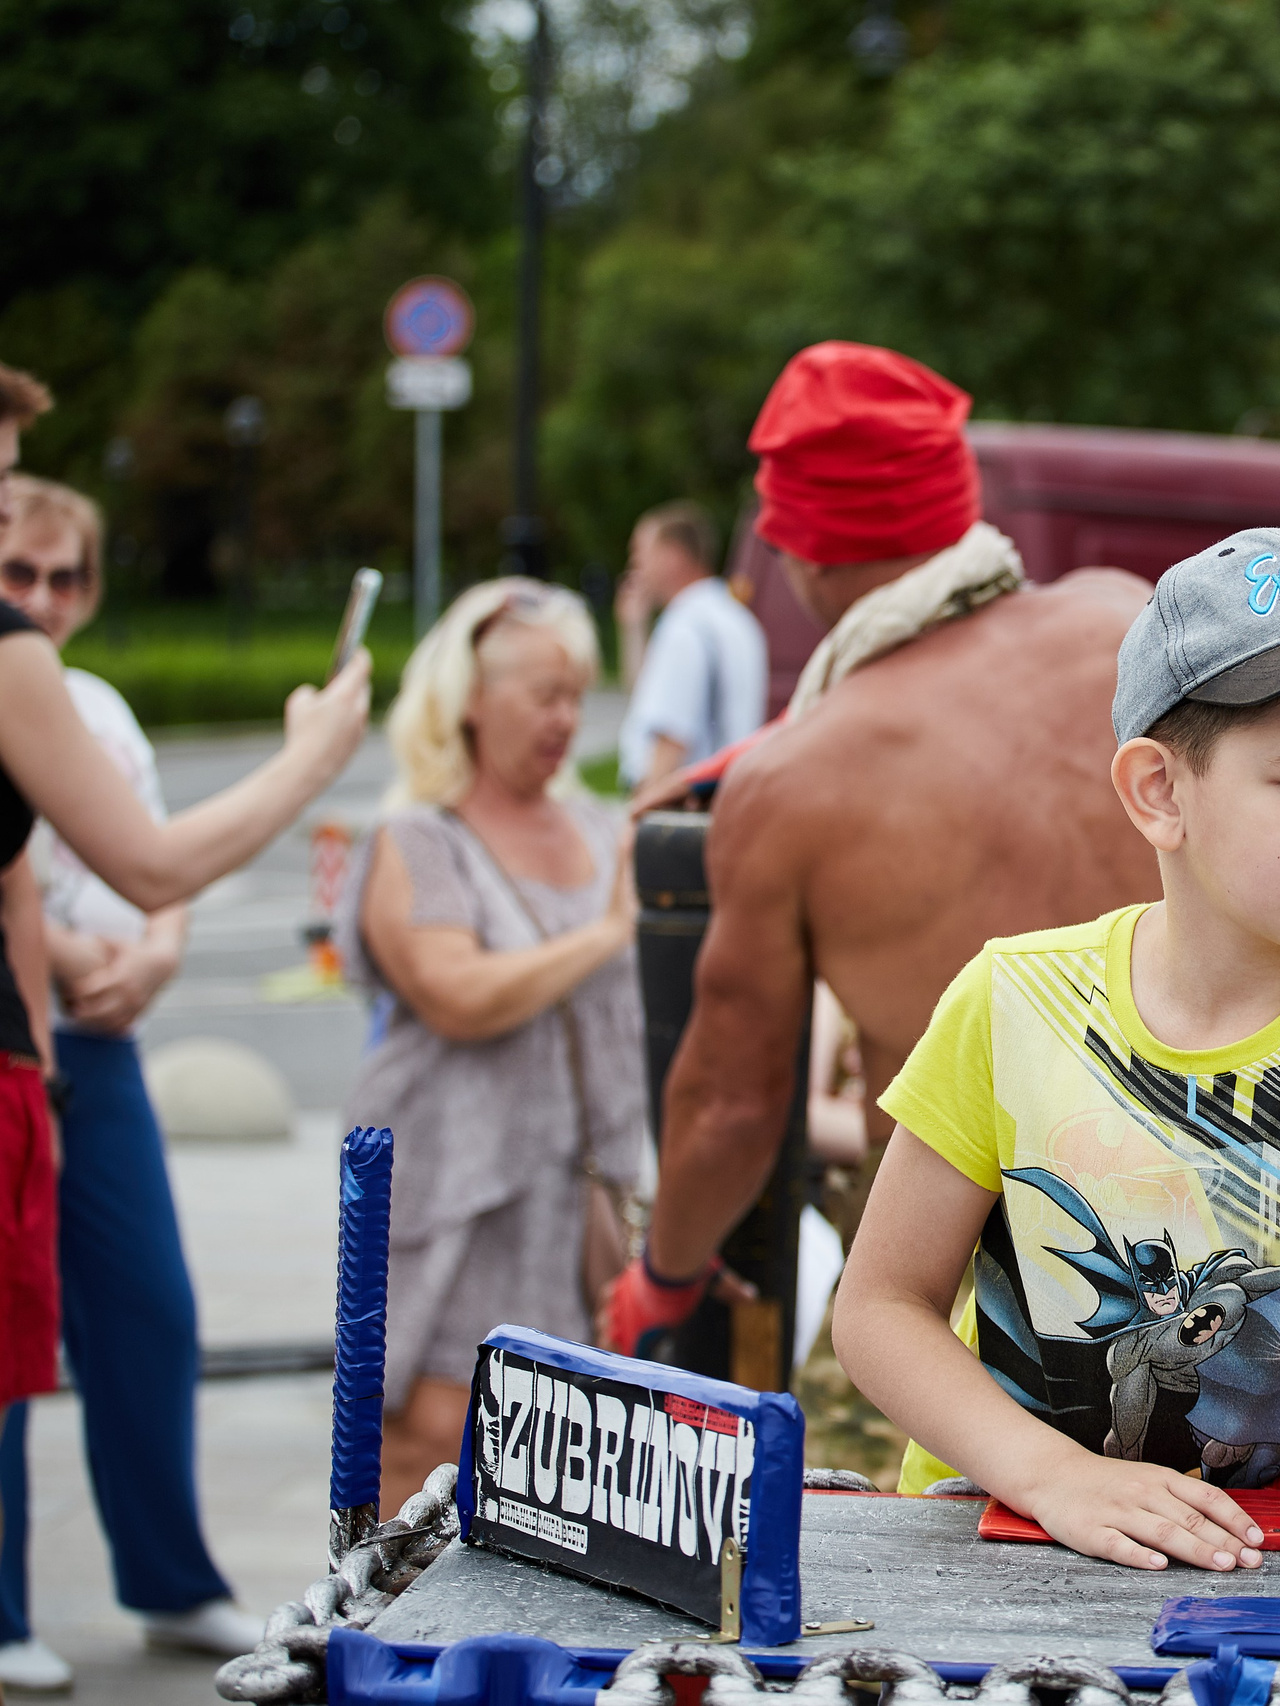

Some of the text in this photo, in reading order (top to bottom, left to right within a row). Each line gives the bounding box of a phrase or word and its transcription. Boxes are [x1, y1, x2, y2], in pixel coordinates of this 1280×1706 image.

[500, 1366, 737, 1566] ZUBRINOV
[500, 1500, 537, 1531] СИЛЬНЫЕ
[538, 1513, 562, 1541] МИРА
